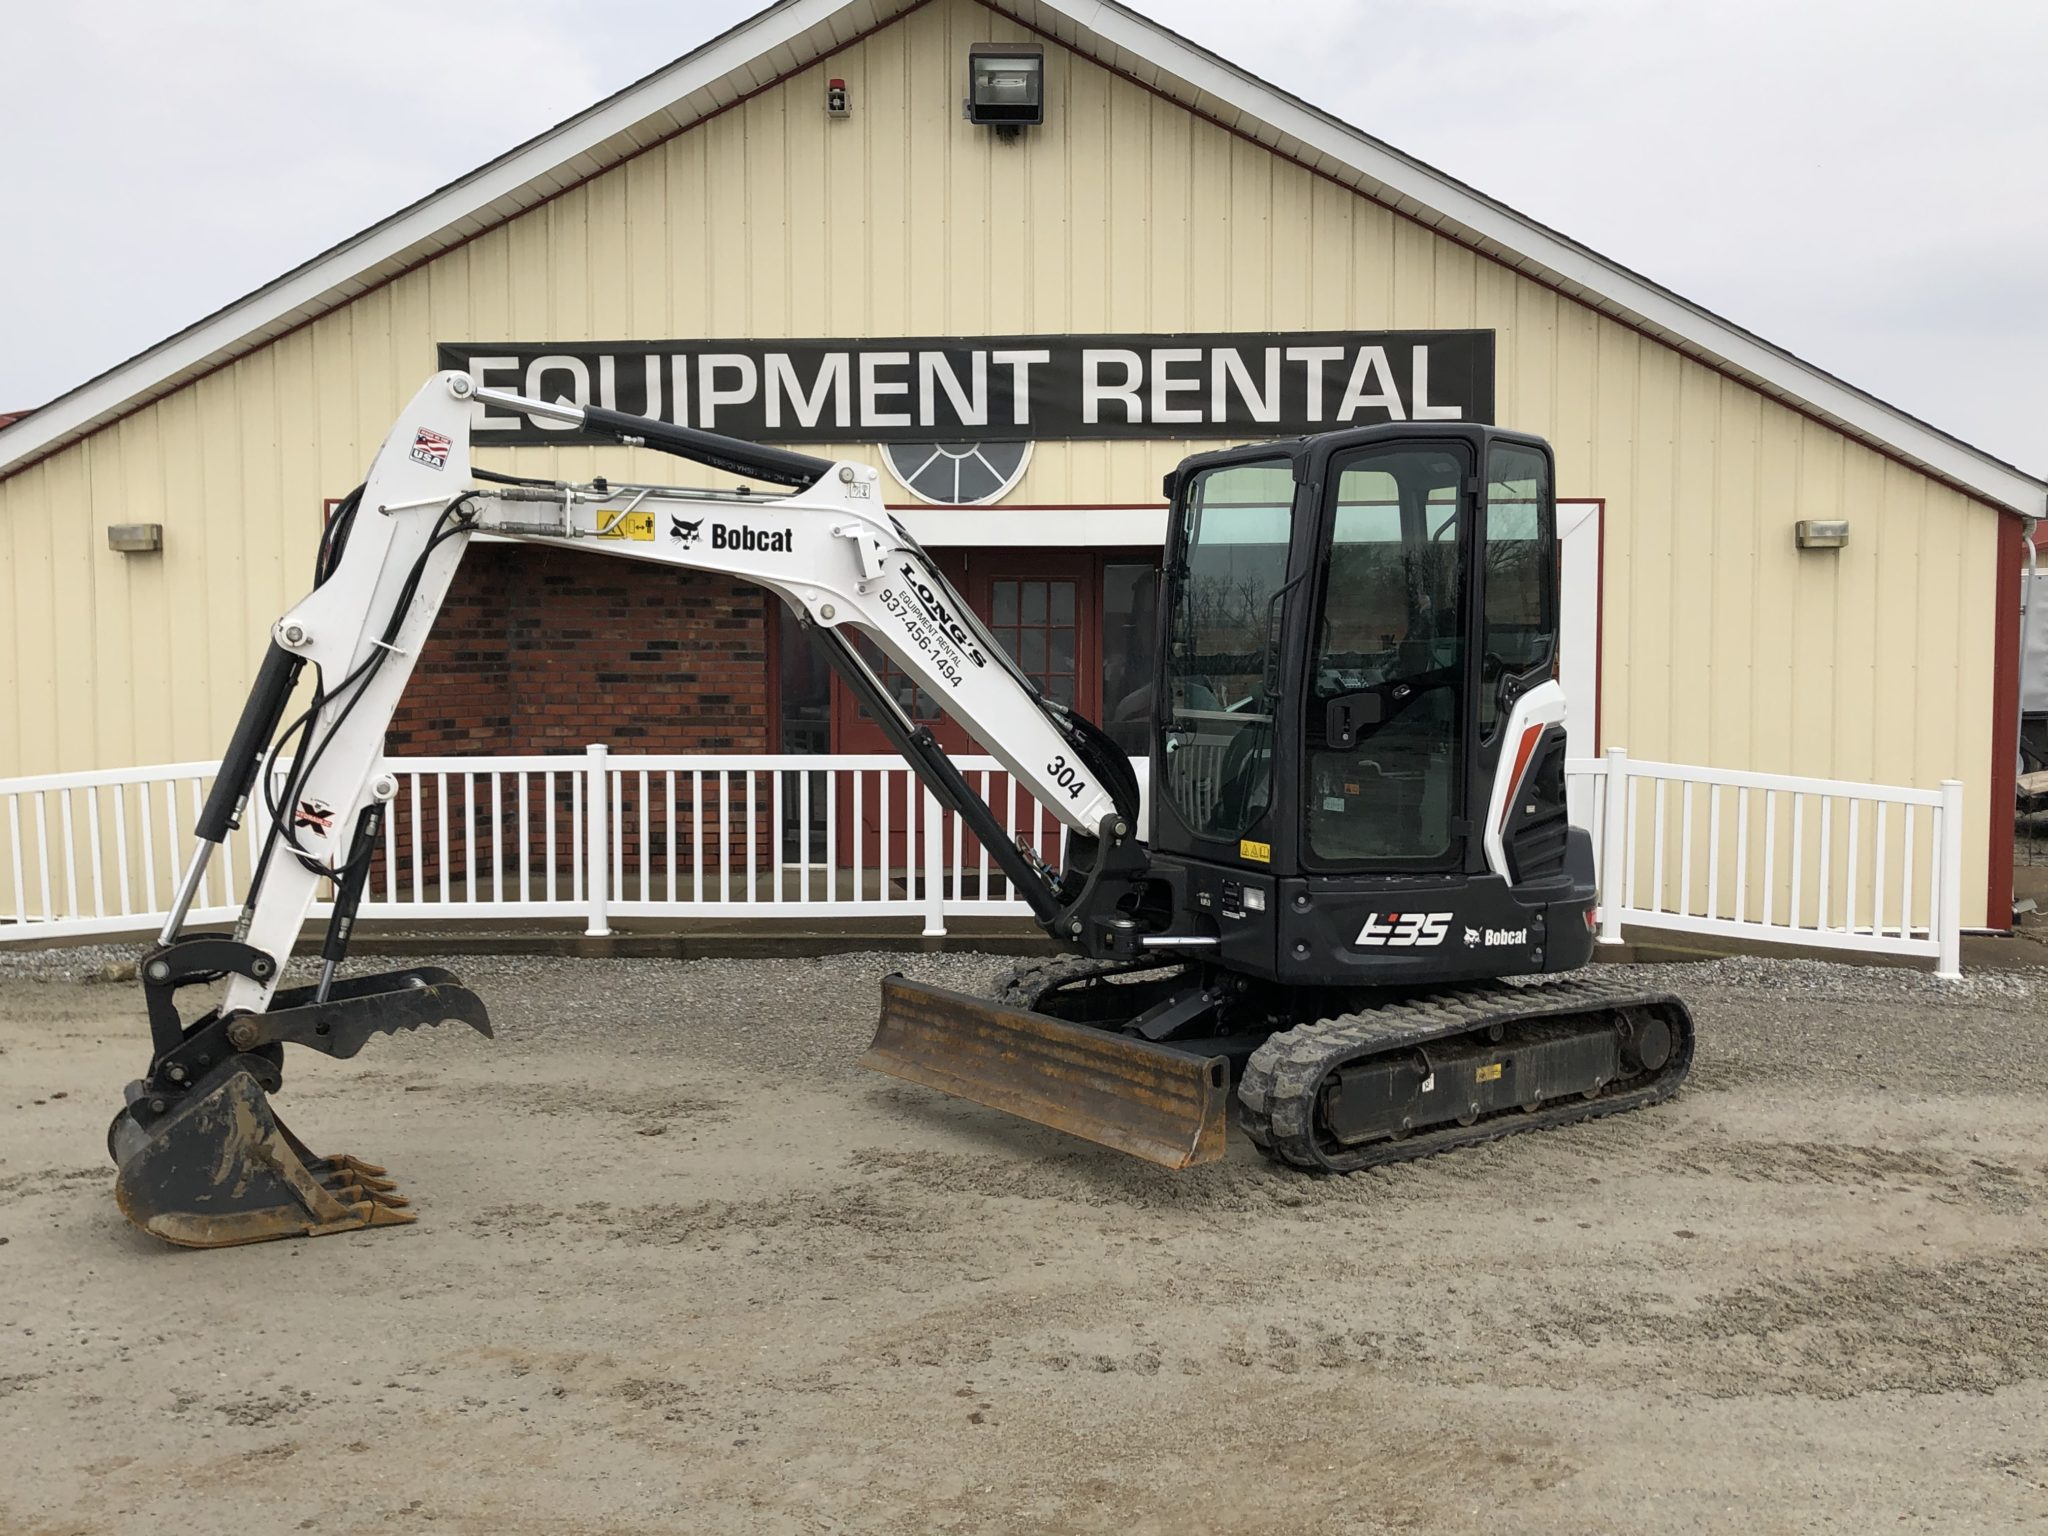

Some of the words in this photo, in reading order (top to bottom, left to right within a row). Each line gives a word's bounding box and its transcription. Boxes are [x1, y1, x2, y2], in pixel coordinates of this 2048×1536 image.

[469, 350, 1050, 431] EQUIPMENT
[1082, 345, 1462, 424] RENTAL
[413, 448, 443, 467] USA
[712, 523, 793, 553] Bobcat
[879, 588, 963, 688] 937-456-1494
[898, 590, 938, 639] EQUIPMENT
[935, 635, 963, 668] RENTAL
[900, 563, 986, 668] LONG'S
[1046, 755, 1086, 800] 304
[1354, 912, 1454, 946] E35
[1484, 928, 1527, 946] Bobcat
